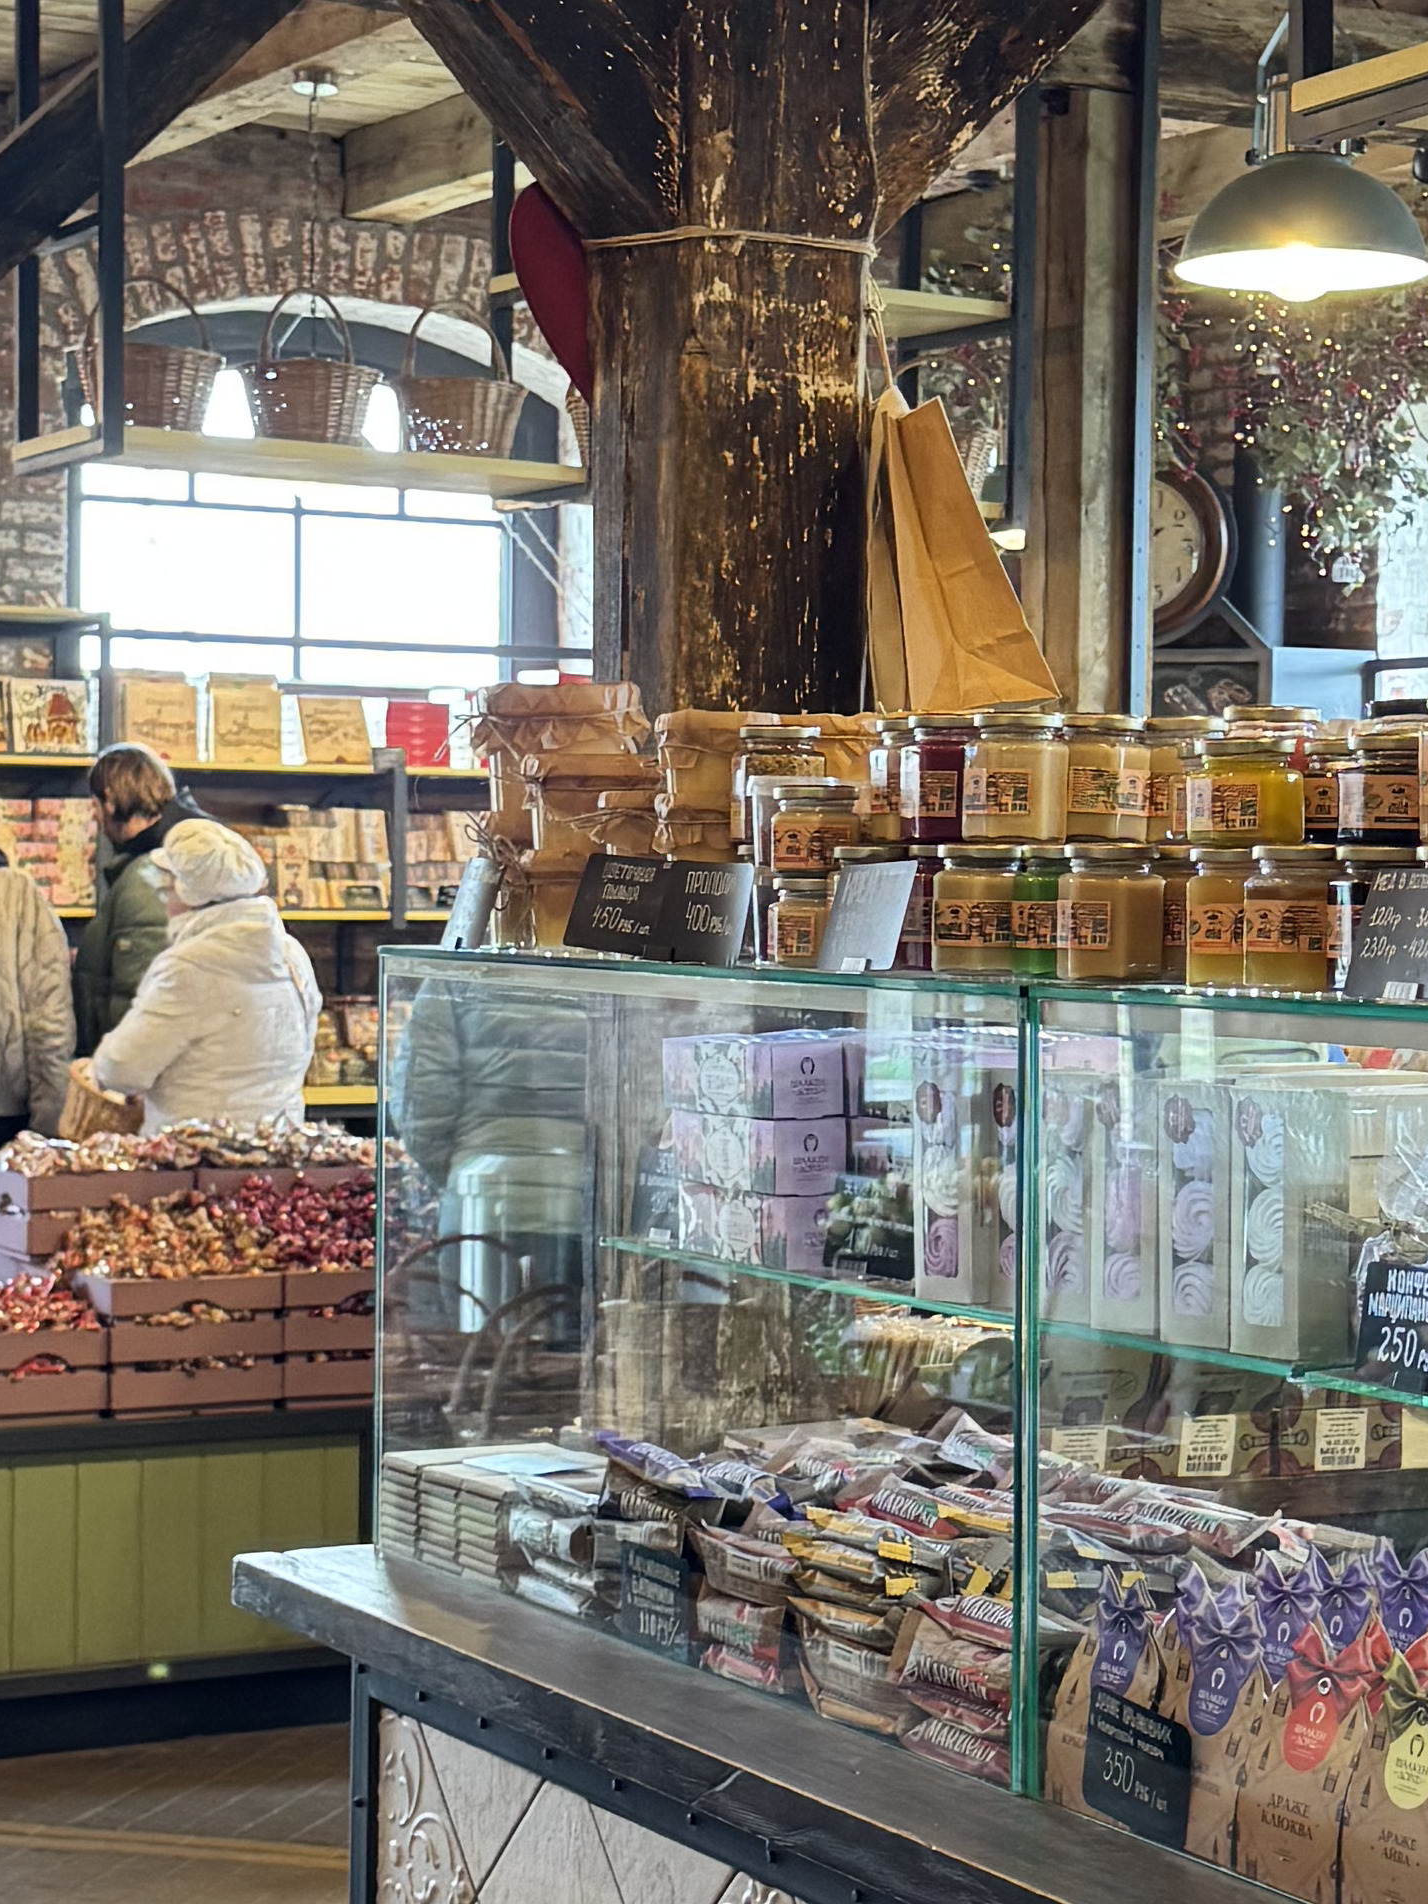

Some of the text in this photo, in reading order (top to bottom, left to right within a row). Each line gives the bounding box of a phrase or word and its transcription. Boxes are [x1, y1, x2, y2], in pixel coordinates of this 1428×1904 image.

[593, 906, 621, 930] 450
[686, 902, 710, 932] 400
[1377, 1326, 1417, 1368] 250
[1138, 1503, 1219, 1533] MARZIPAN
[958, 1594, 1014, 1629] MARZIPA
[918, 1655, 988, 1701] MARZIPAN
[923, 1718, 996, 1763] MARZIPAN
[1103, 1746, 1134, 1793] 350
[1267, 1793, 1311, 1818] ДРАЖЕ
[1261, 1810, 1313, 1840] КЛЮКВА
[1378, 1828, 1417, 1851] ДРАЖЕ
[1381, 1846, 1411, 1867] АЙВА
